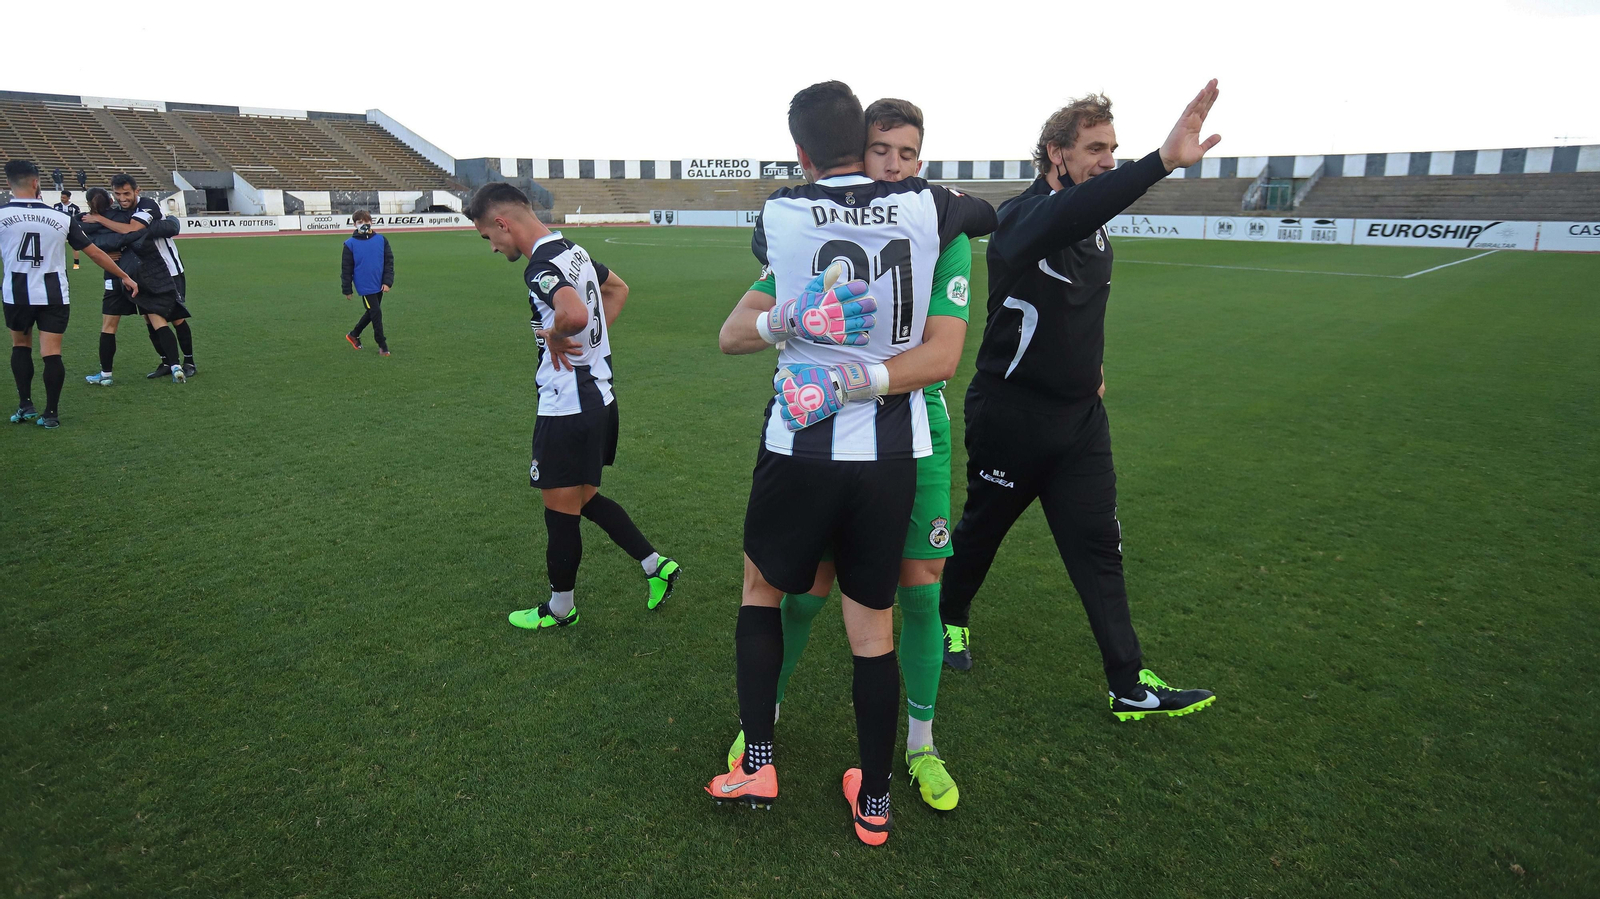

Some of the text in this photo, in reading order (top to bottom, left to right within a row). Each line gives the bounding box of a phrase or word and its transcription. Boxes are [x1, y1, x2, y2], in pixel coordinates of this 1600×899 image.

[690, 159, 750, 168] ALFREDO
[687, 169, 752, 178] GALLARDO
[763, 168, 789, 176] LOTUS
[388, 216, 425, 225] LEGEA
[810, 204, 899, 228] DANESE
[1131, 216, 1152, 225] LA
[22, 214, 63, 232] FERNANDEZ
[1277, 229, 1303, 240] UBAGO
[1311, 230, 1338, 241] UBAGO
[1366, 223, 1482, 240] EUROSHIP
[17, 231, 44, 268] 4
[585, 280, 604, 349] 3
[979, 469, 1015, 489] LEGEA
[992, 468, 1006, 479] M.V
